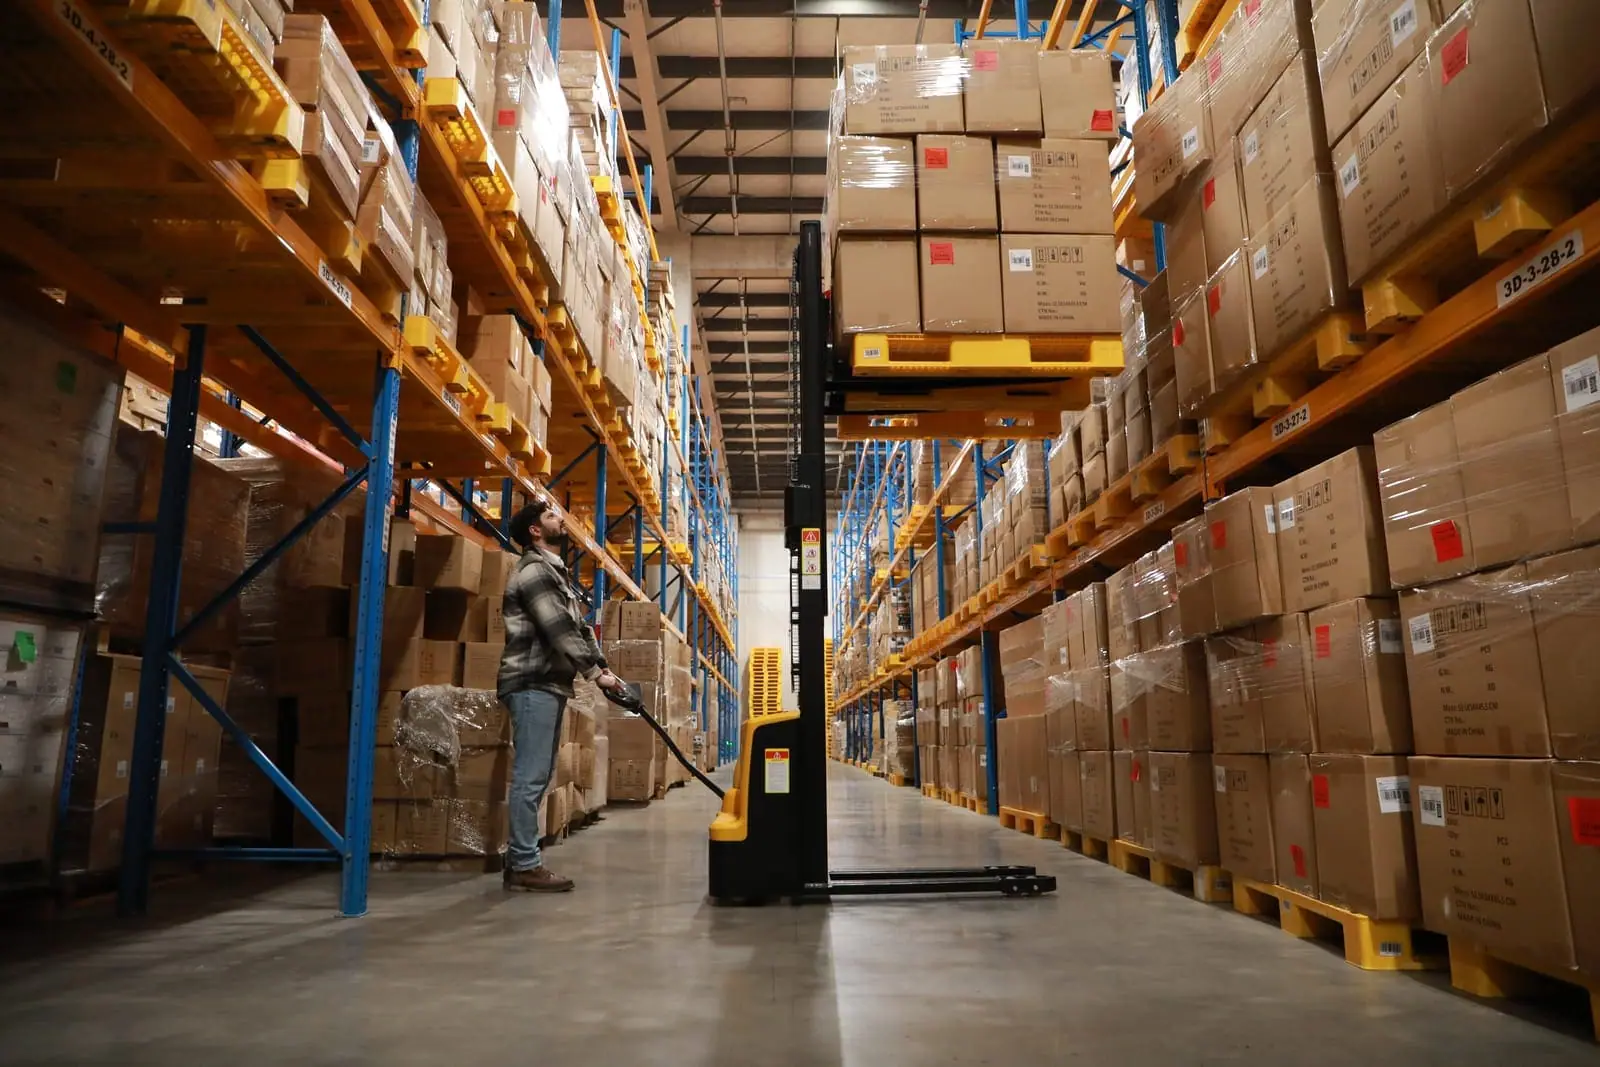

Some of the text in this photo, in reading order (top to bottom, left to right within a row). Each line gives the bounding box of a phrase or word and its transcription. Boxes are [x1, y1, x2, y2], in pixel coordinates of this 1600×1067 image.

[61, 1, 128, 80] 3D-4-28-2
[1503, 239, 1576, 298] 3D-3-28-2
[1274, 408, 1307, 437] 3D-3-27-2
